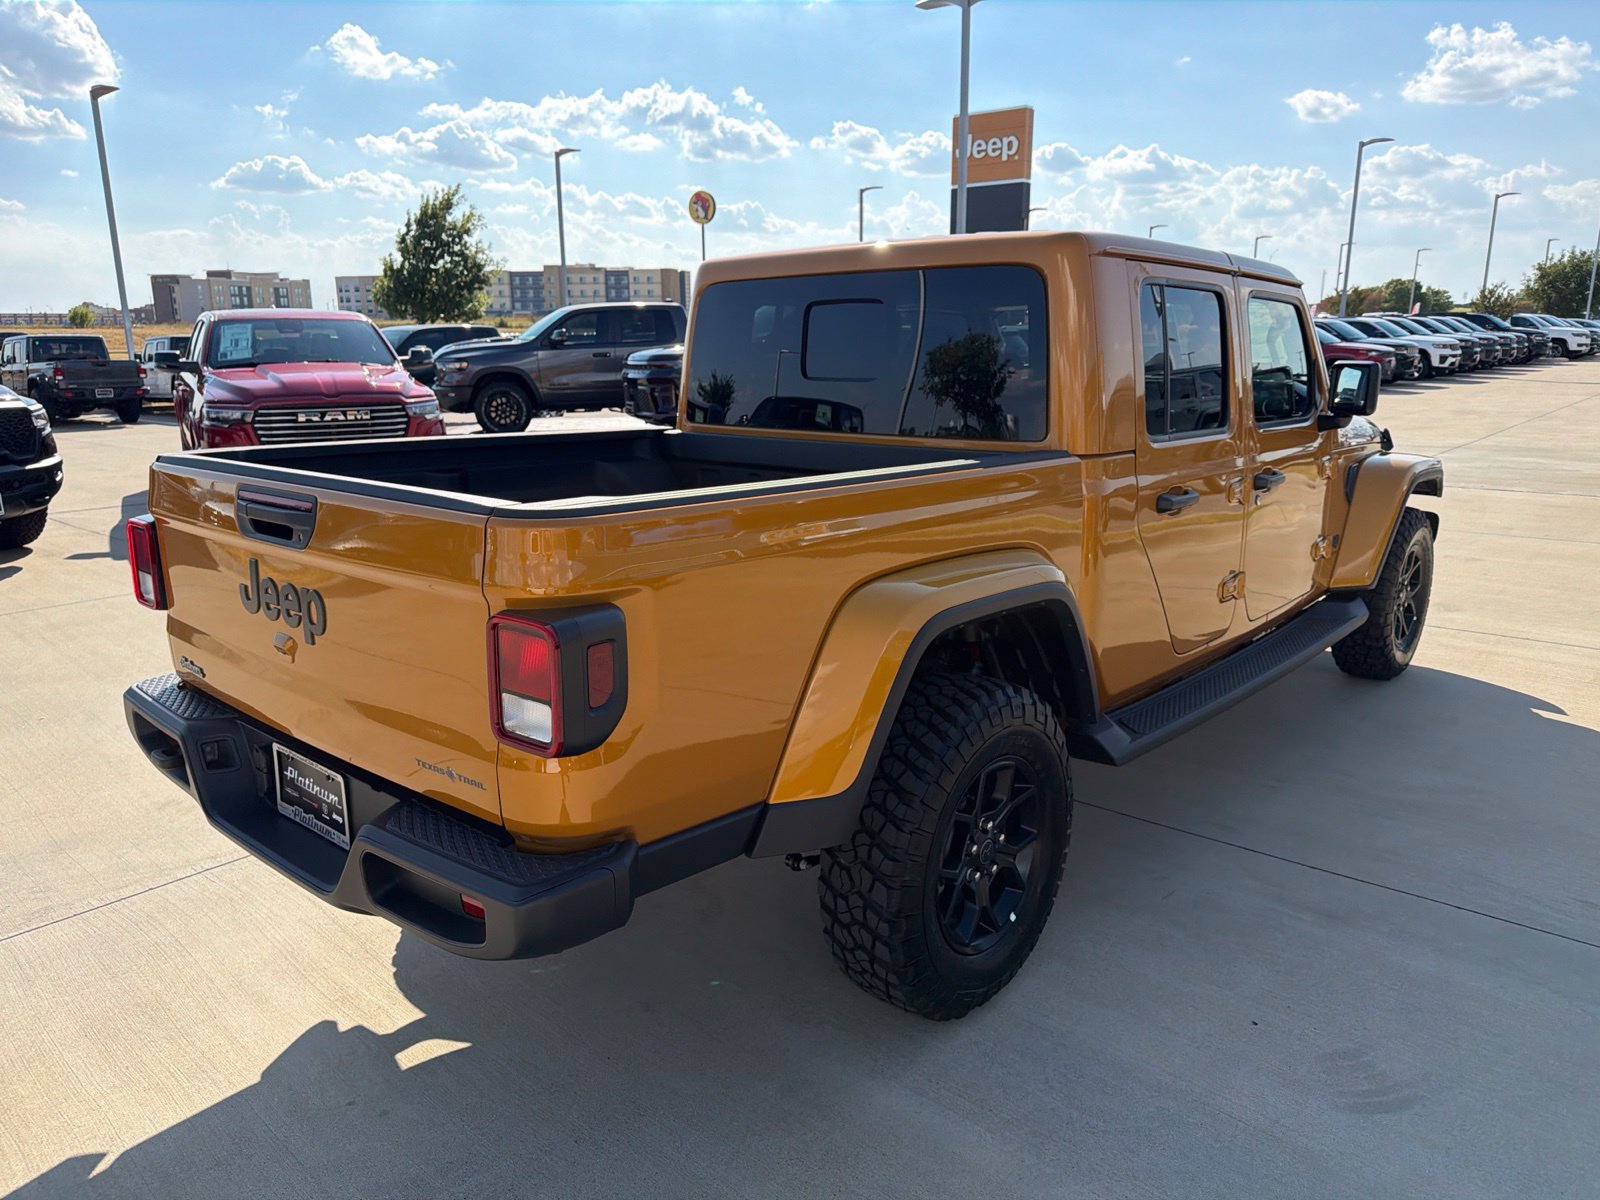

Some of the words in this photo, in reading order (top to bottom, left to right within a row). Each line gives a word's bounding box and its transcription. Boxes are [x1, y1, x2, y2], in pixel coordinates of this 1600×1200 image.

[297, 411, 370, 422] RAM
[239, 557, 327, 645] Jeep
[283, 766, 342, 809] Platinum
[415, 757, 446, 775] TEXAS
[456, 773, 487, 790] TRAIL
[294, 807, 335, 839] Platinum
